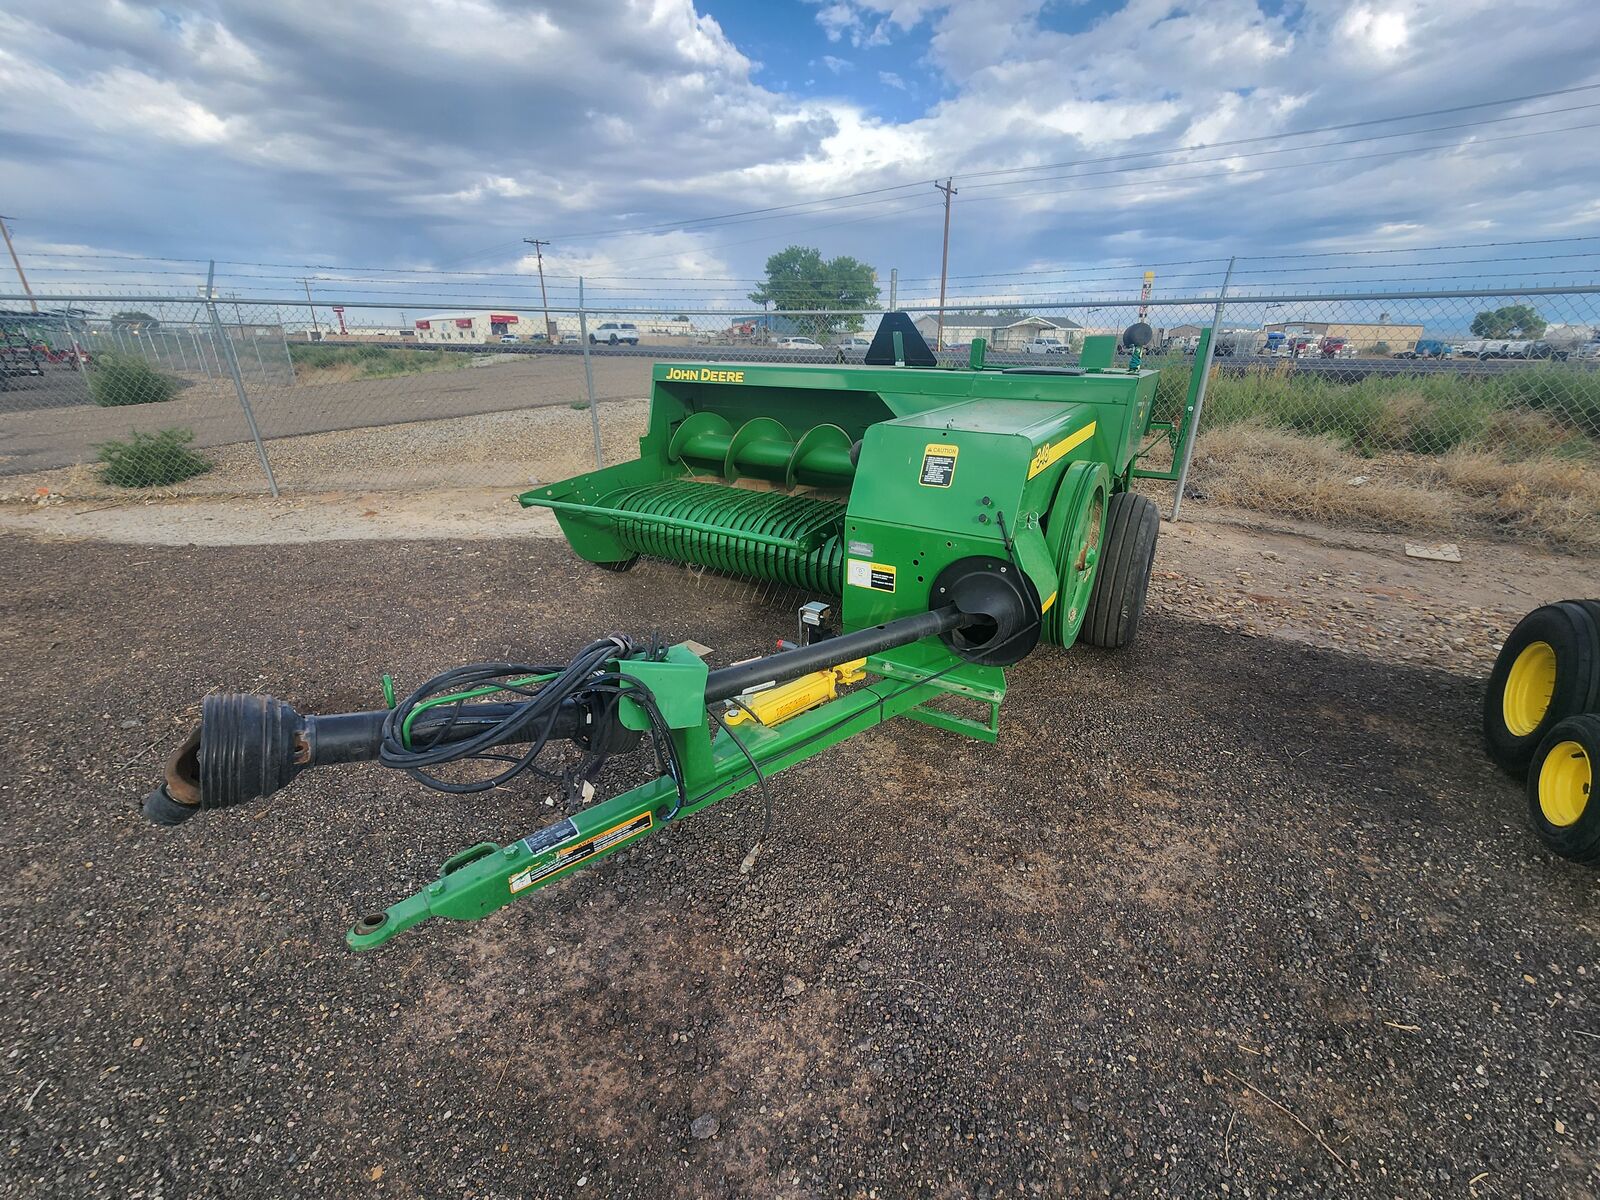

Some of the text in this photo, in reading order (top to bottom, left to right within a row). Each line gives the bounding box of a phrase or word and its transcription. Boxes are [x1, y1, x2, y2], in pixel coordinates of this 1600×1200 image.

[666, 367, 744, 382] JOHN DEERE
[933, 447, 957, 455] CAUTION
